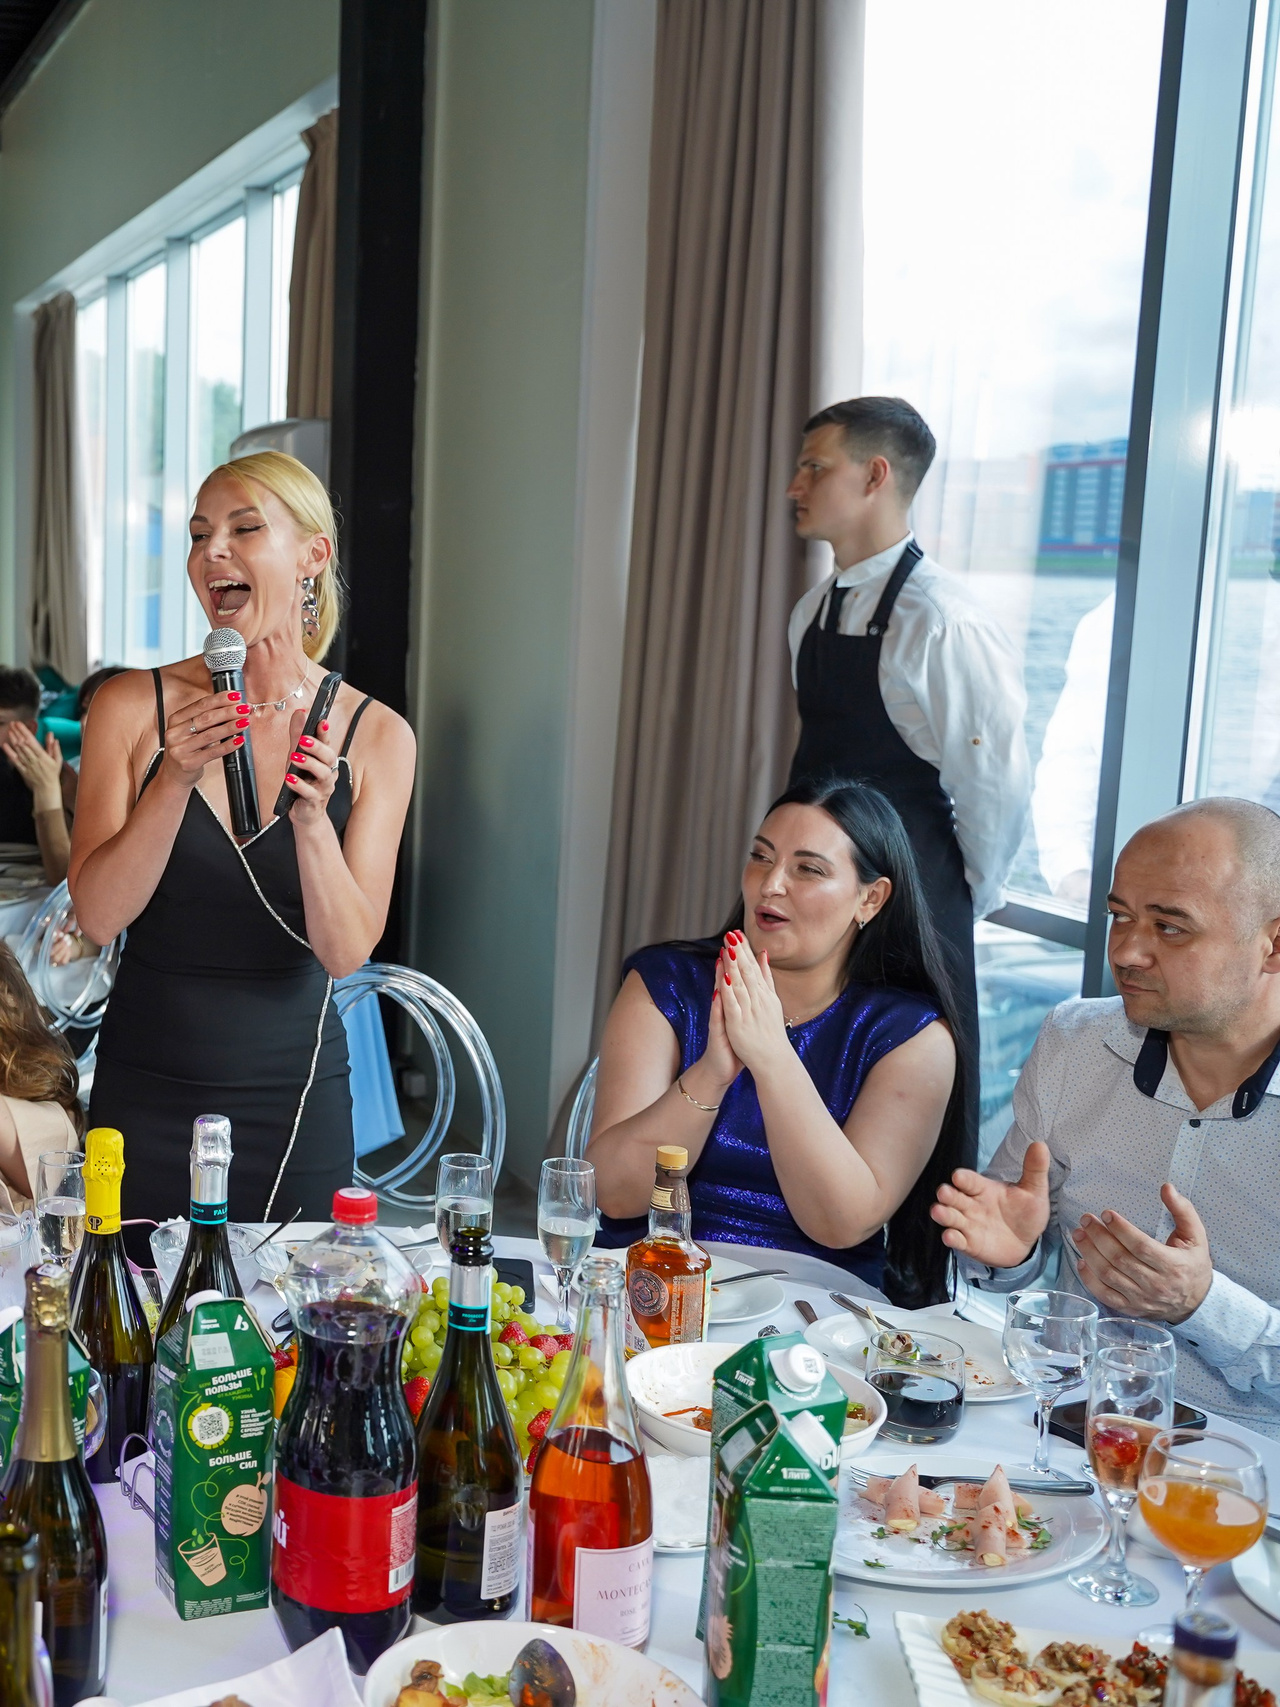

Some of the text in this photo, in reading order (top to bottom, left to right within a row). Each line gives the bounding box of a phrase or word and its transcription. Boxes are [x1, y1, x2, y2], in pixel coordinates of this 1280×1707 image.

[211, 1367, 253, 1386] БОЛЬШЕ
[205, 1380, 243, 1396] ПОЛЬЗЫ
[209, 1450, 252, 1467] БОЛЬШЕ
[239, 1460, 258, 1470] СИЛ
